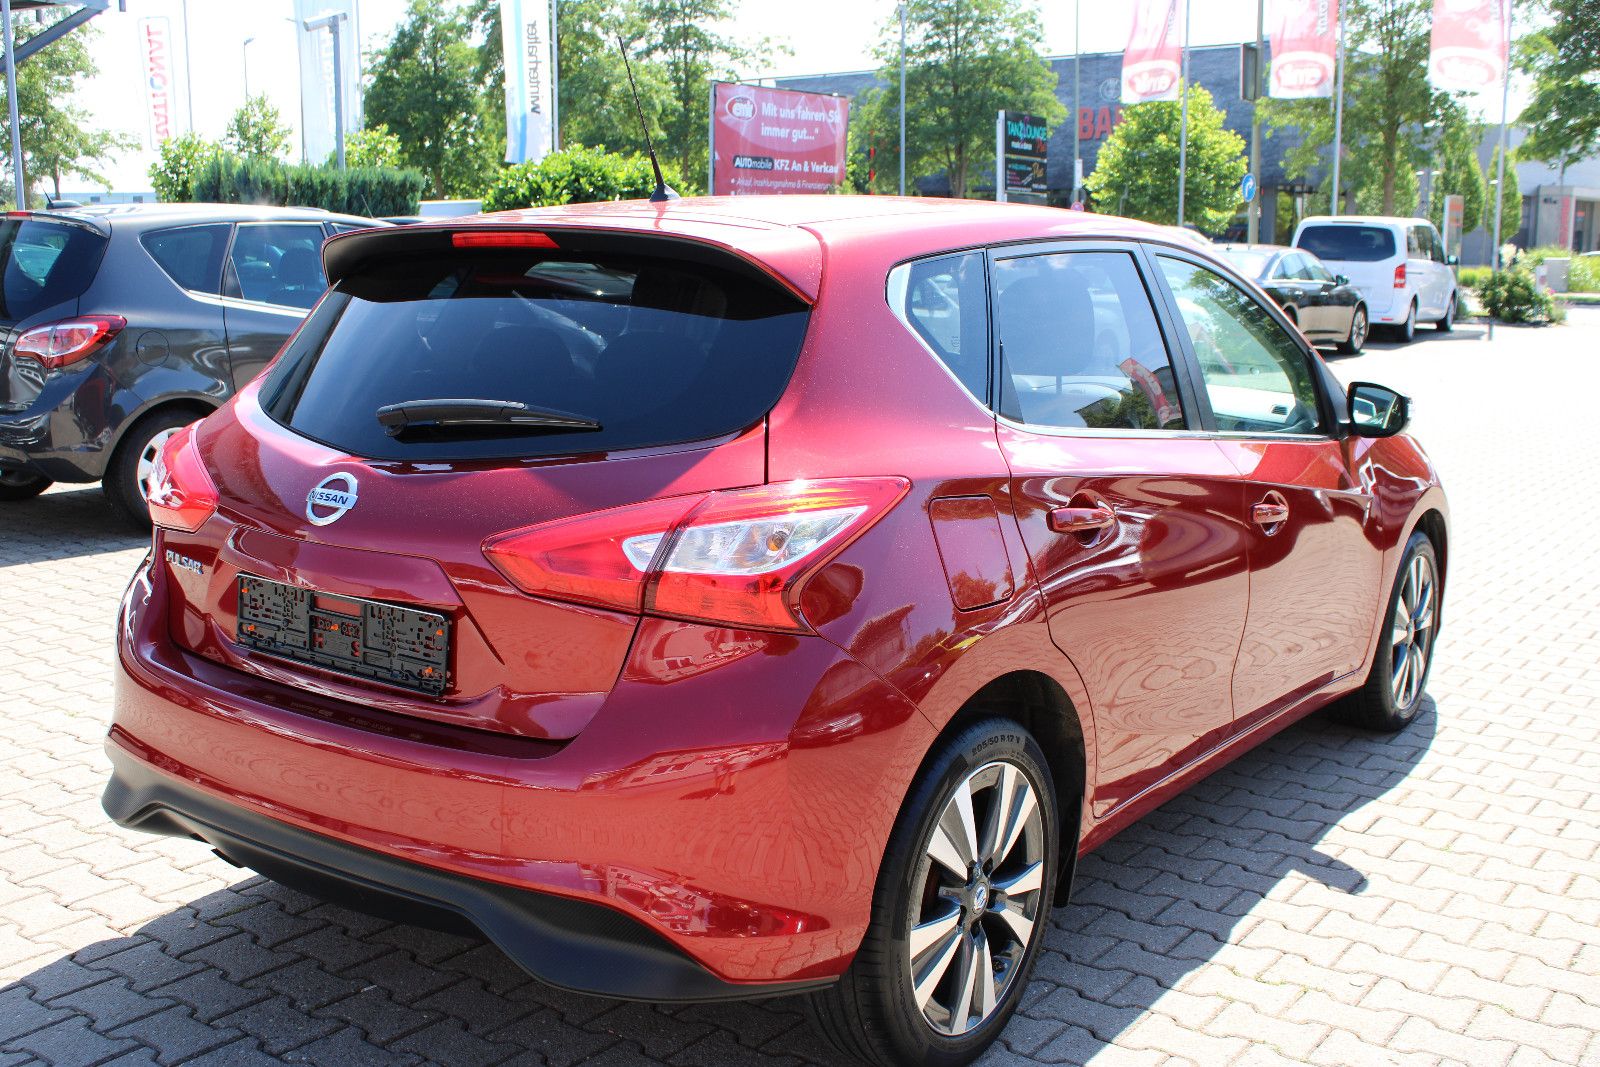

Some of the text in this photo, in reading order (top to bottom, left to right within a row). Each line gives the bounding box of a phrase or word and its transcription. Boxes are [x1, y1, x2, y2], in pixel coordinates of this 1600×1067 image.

[761, 101, 778, 118] Mit
[780, 107, 796, 119] uns
[797, 105, 825, 123] fahren
[761, 122, 791, 138] immer
[774, 159, 790, 171] KFZ
[309, 490, 349, 505] NISSAN
